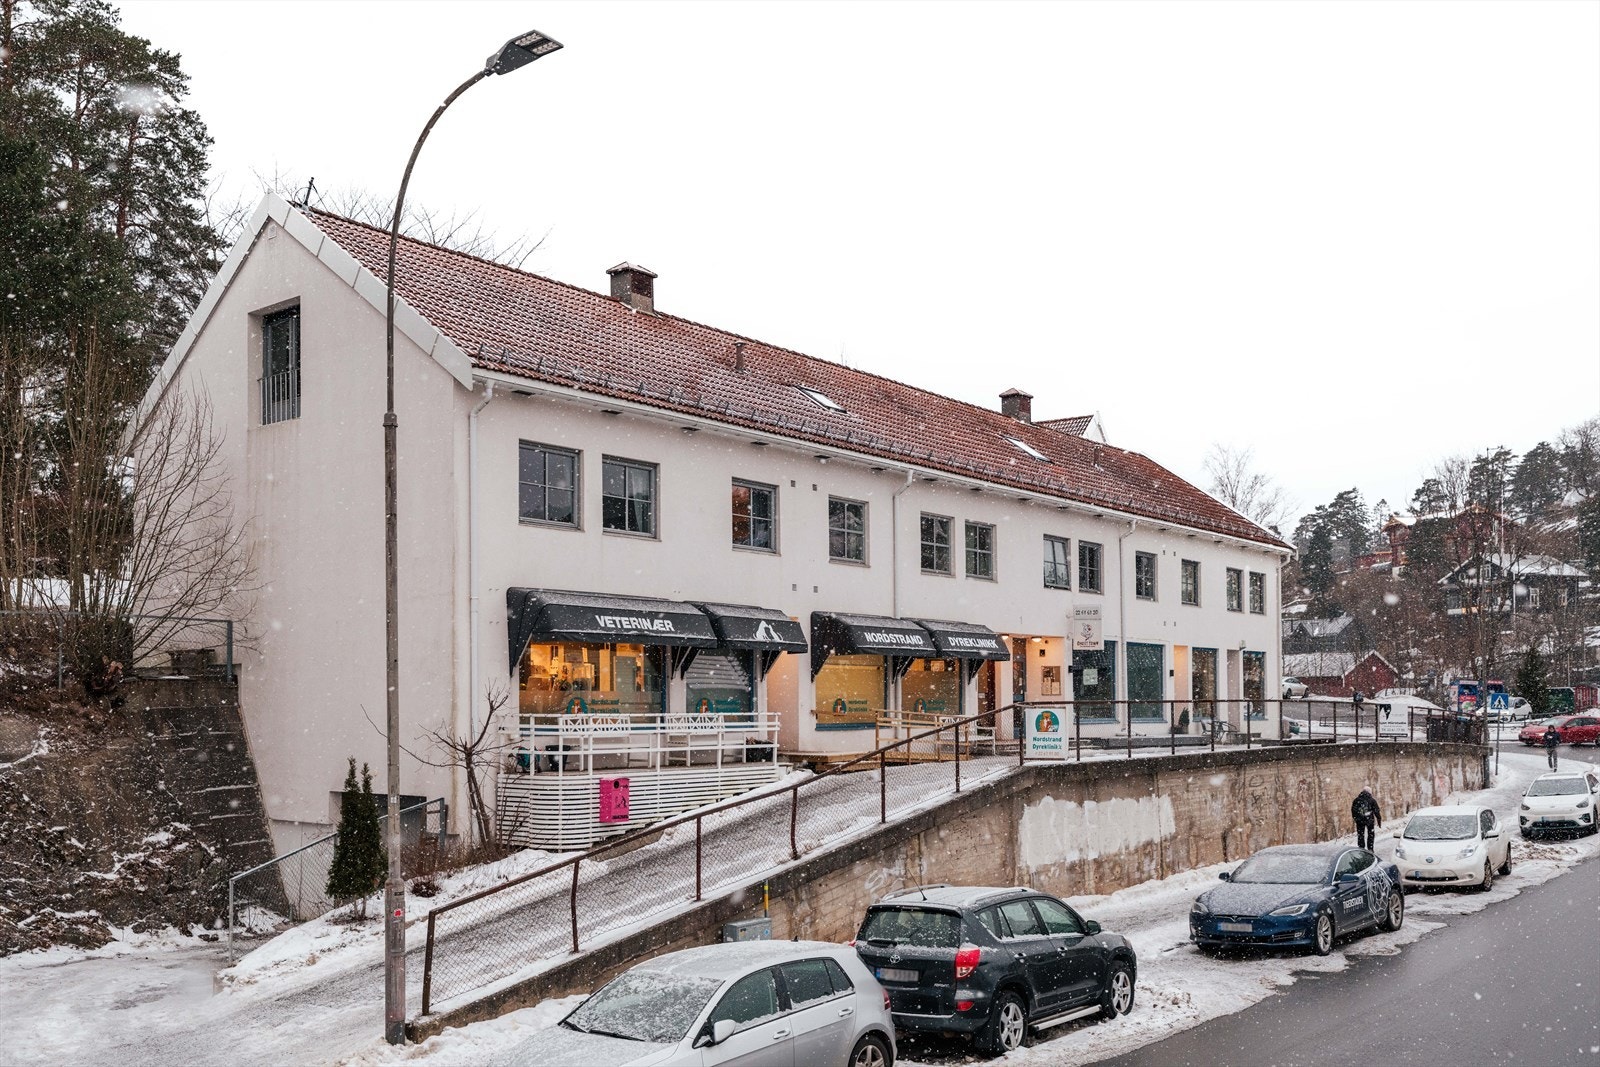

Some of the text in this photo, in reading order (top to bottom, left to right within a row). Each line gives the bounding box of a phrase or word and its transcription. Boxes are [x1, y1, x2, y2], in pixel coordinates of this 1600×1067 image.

[595, 614, 675, 632] VETERINÆR
[864, 631, 999, 649] NORDSTRAND DYREKLINIKK
